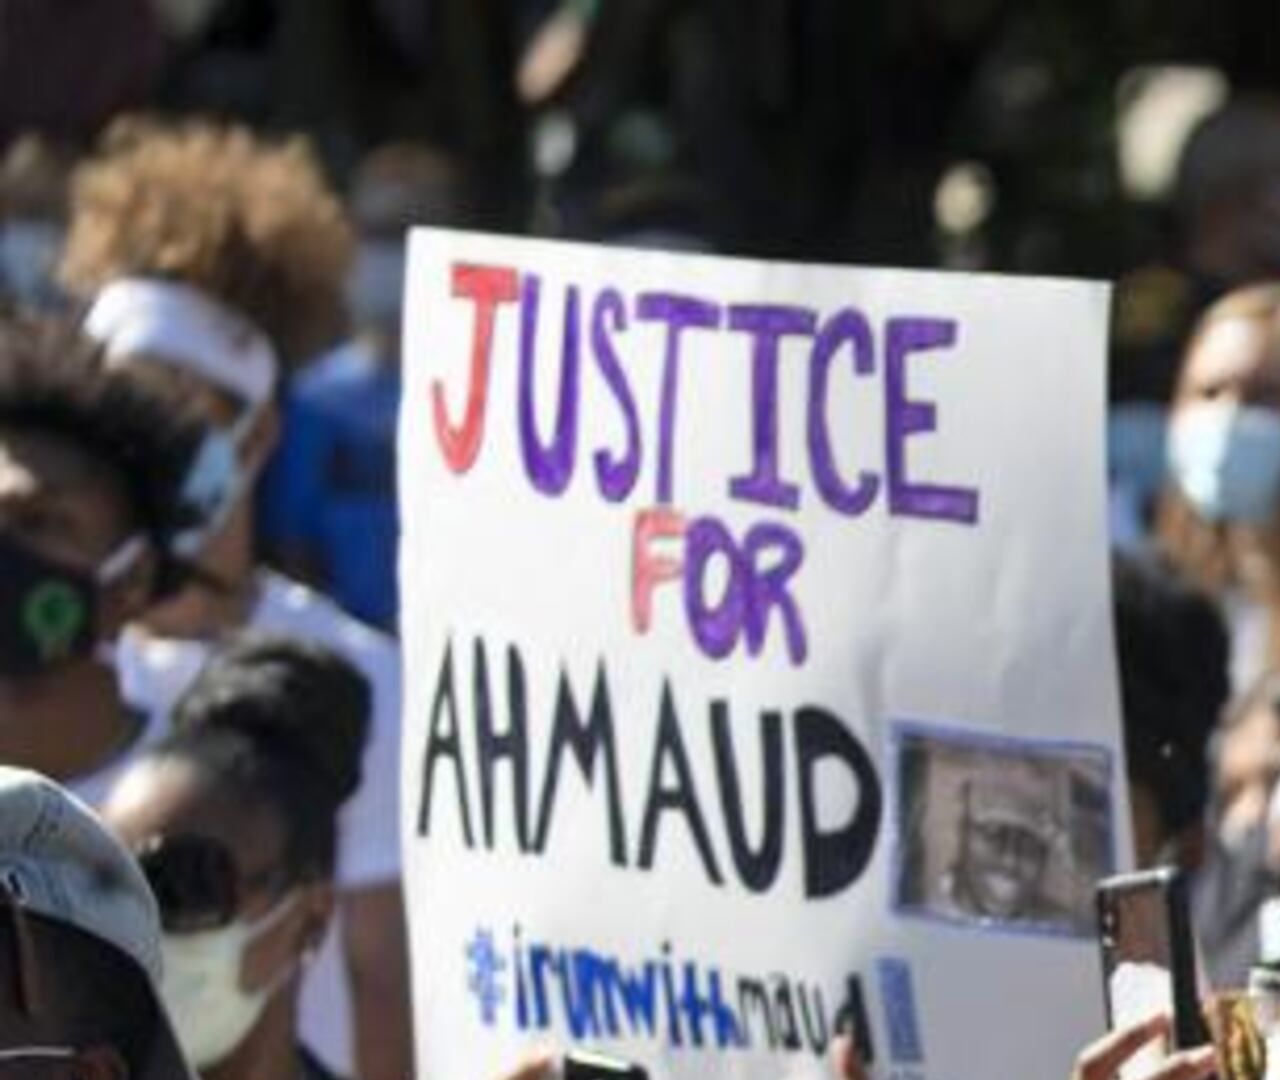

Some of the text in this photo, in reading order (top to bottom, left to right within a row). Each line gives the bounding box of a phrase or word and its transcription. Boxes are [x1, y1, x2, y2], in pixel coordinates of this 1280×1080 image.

[430, 260, 980, 526] JUSTICE
[630, 507, 808, 668] FOR
[417, 630, 884, 900] AHMAUD
